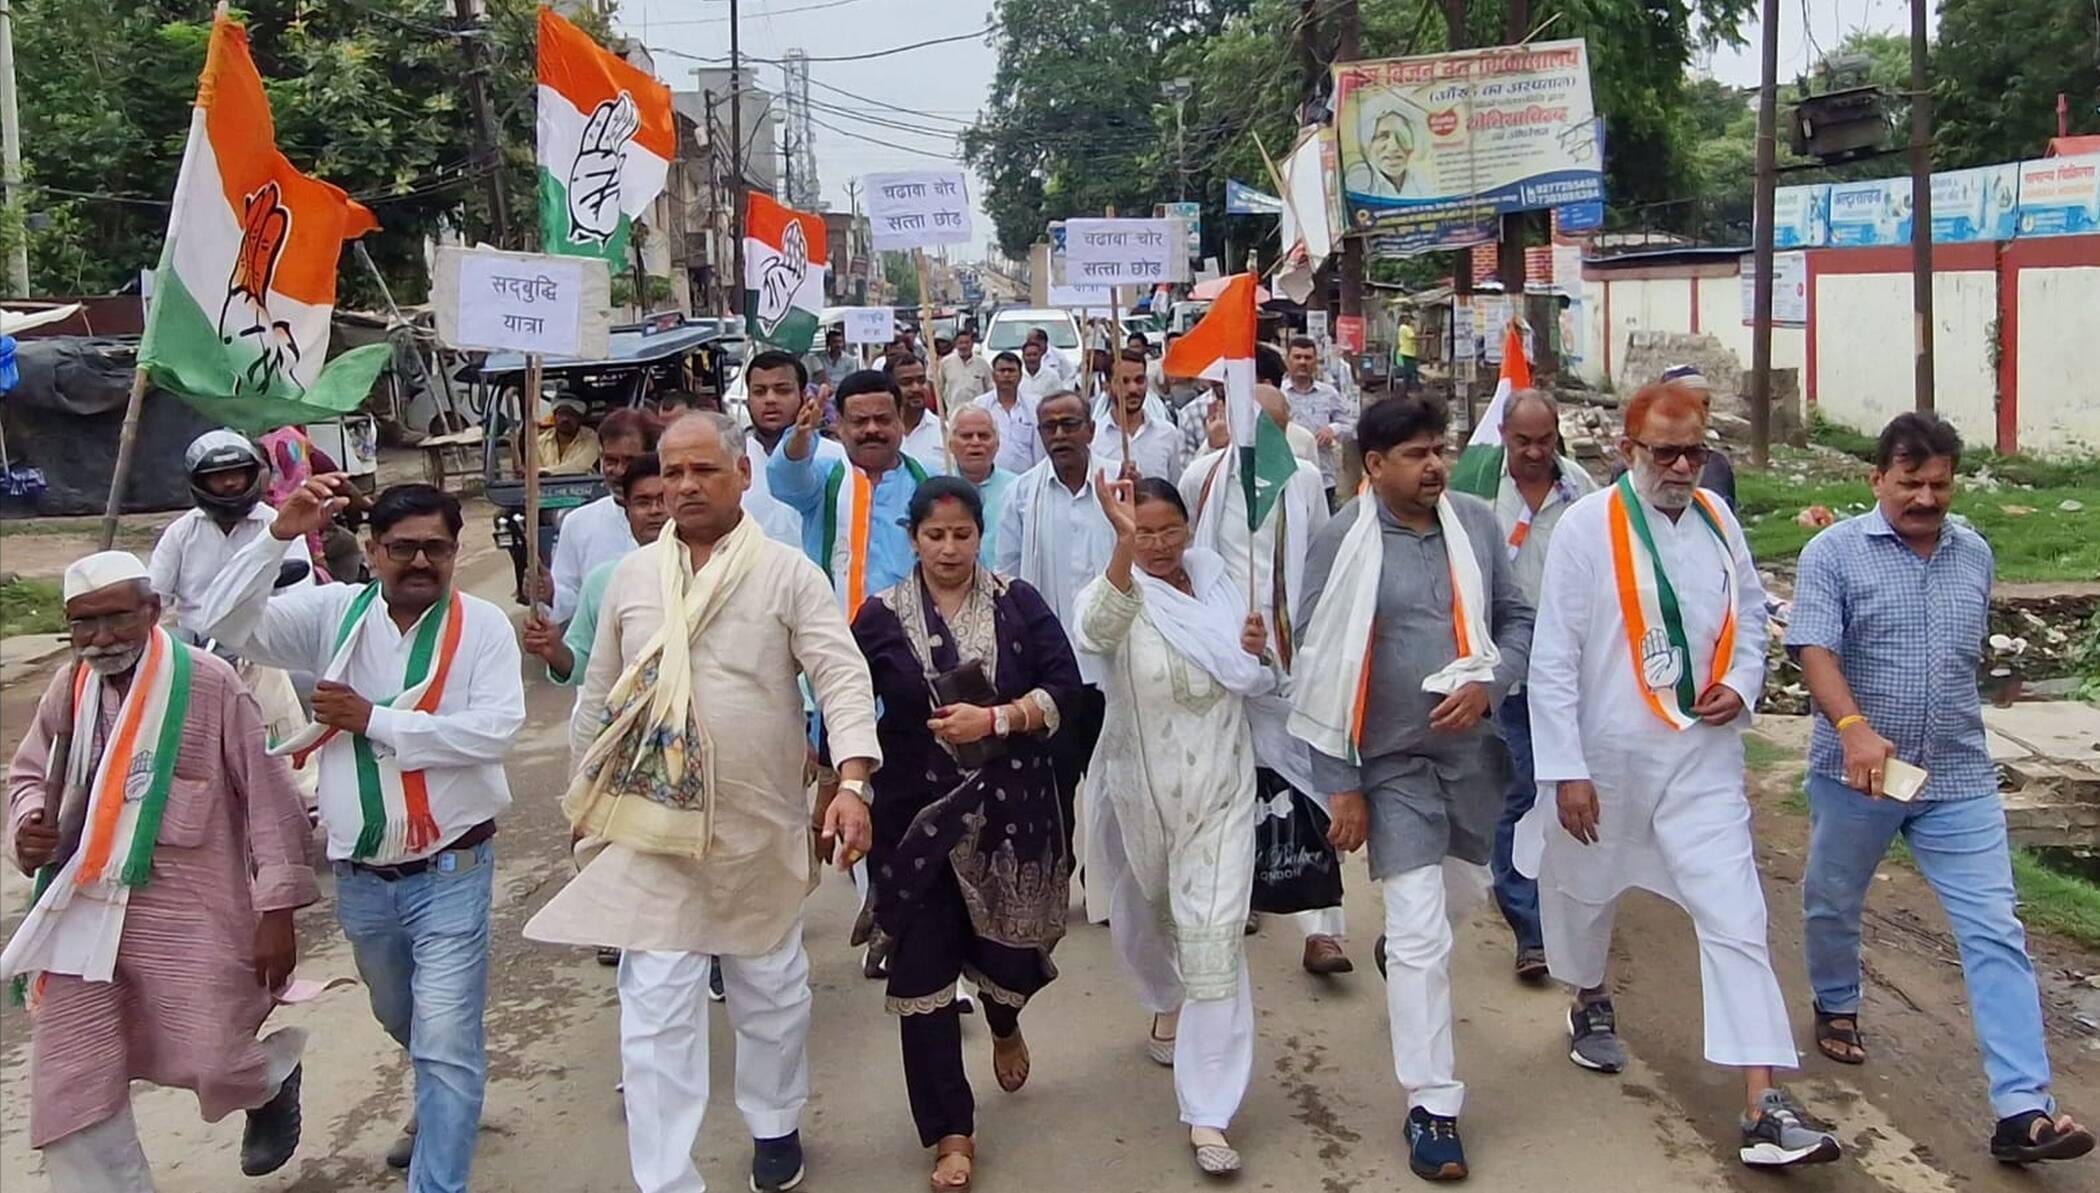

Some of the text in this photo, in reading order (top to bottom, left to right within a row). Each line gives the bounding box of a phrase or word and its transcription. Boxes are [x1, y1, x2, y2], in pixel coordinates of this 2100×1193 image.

[933, 178, 957, 196] चोर
[886, 213, 926, 231] सत्ता
[1135, 227, 1163, 246] चोर
[1082, 261, 1122, 276] सत्ता
[502, 314, 545, 335] यात्रा
